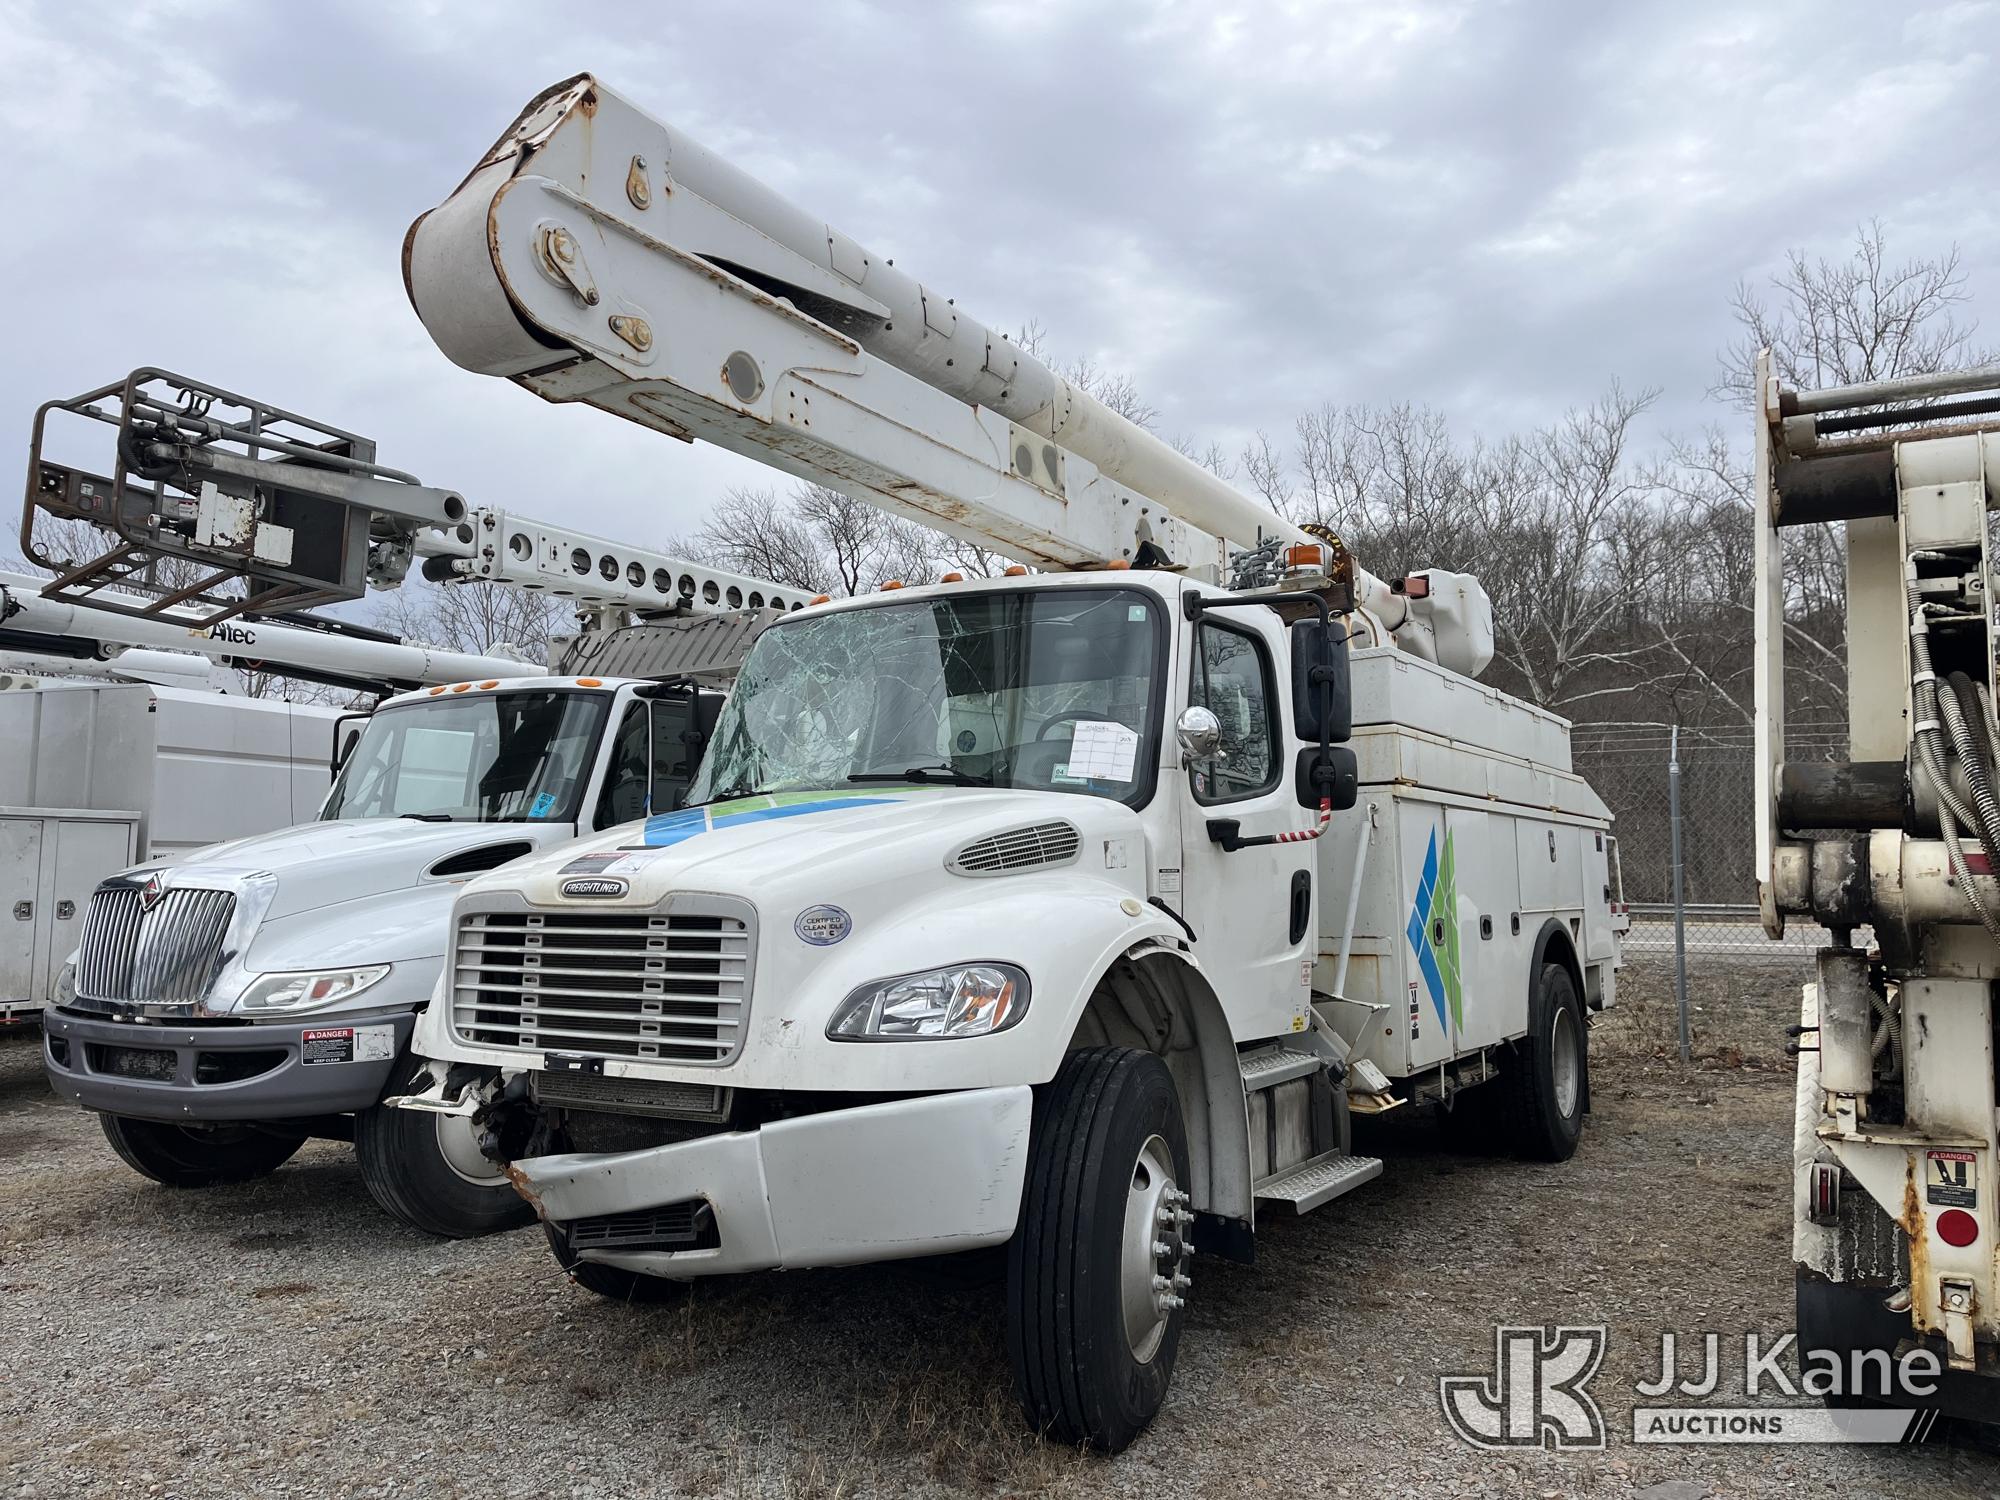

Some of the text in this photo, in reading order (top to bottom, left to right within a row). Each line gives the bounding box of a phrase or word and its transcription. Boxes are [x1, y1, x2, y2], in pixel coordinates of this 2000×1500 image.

[209, 623, 256, 645] Altec
[565, 882, 620, 893] FREIGHTLINER
[316, 1030, 348, 1039] DANGER
[1940, 1152, 1973, 1161] DANGER
